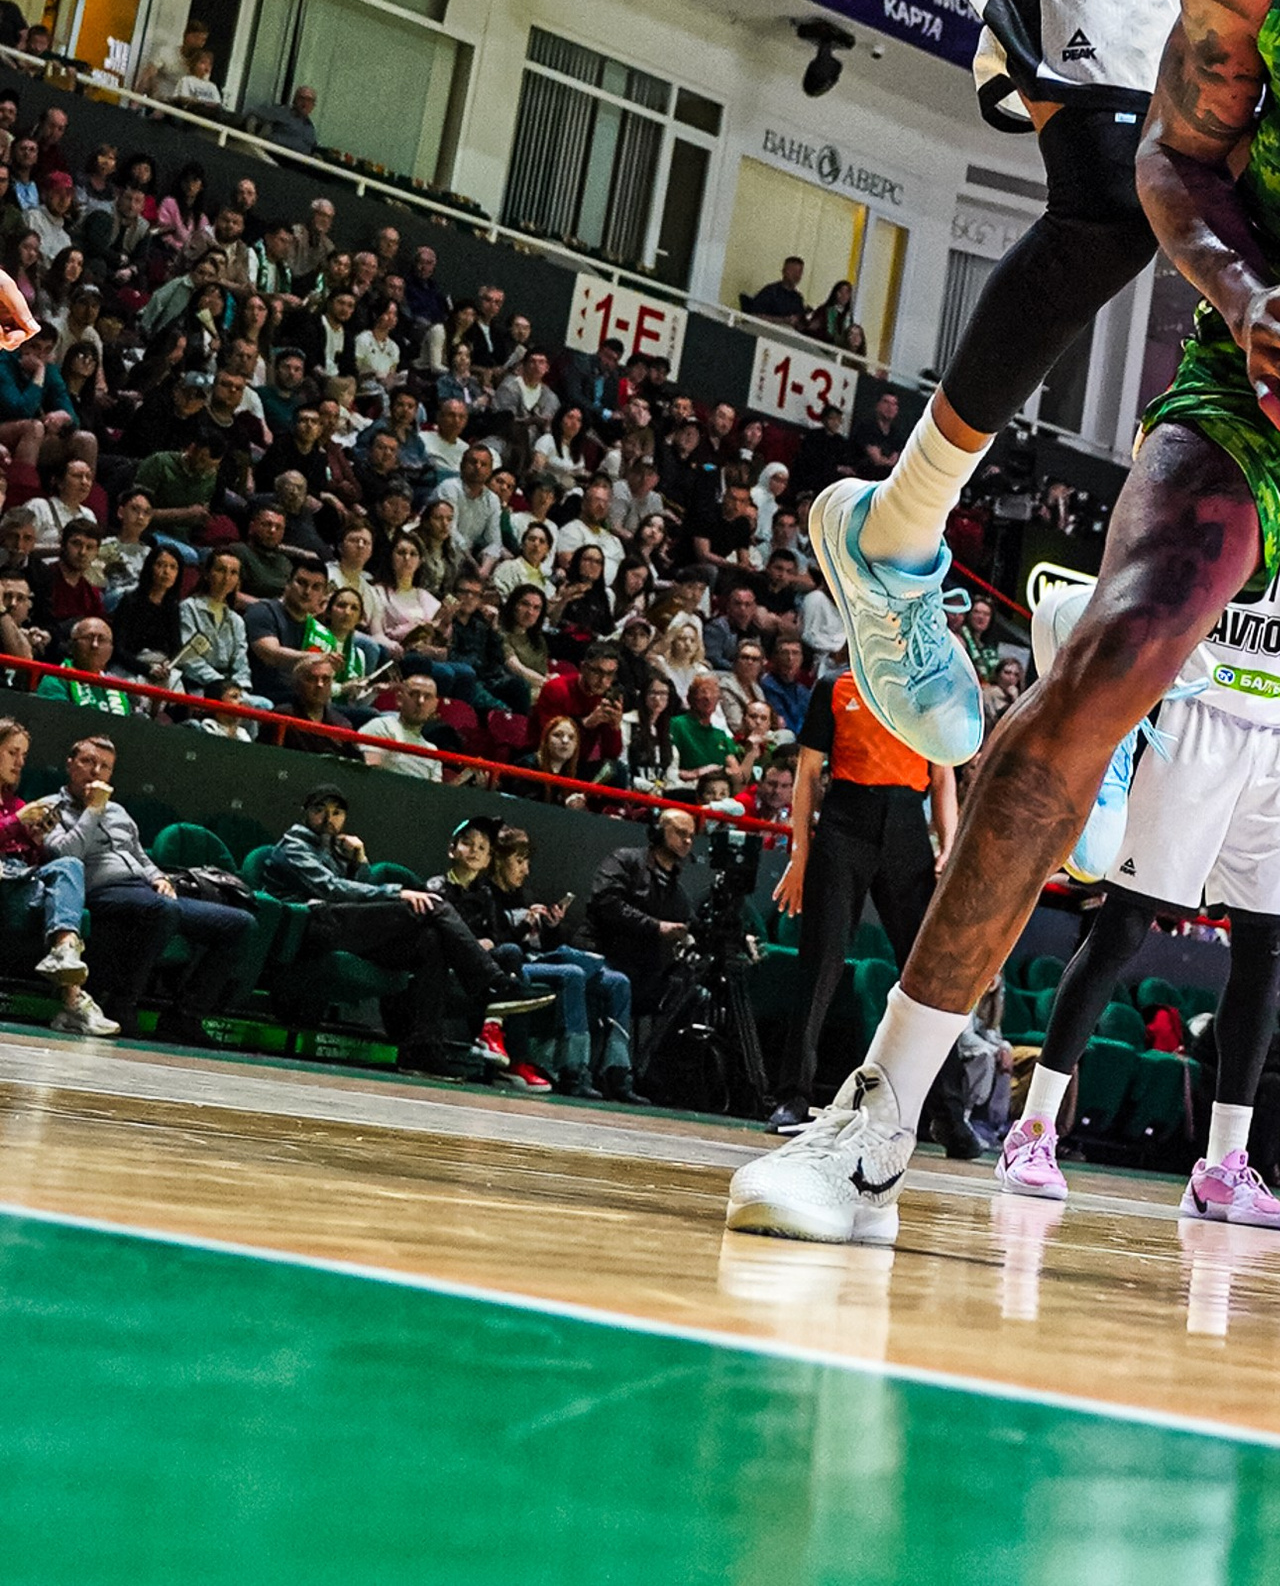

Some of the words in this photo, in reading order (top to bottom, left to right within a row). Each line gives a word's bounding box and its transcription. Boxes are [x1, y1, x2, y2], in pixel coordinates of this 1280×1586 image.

[1062, 47, 1097, 62] PEAK
[763, 128, 816, 171] БАНК
[842, 163, 904, 206] АВЕРС
